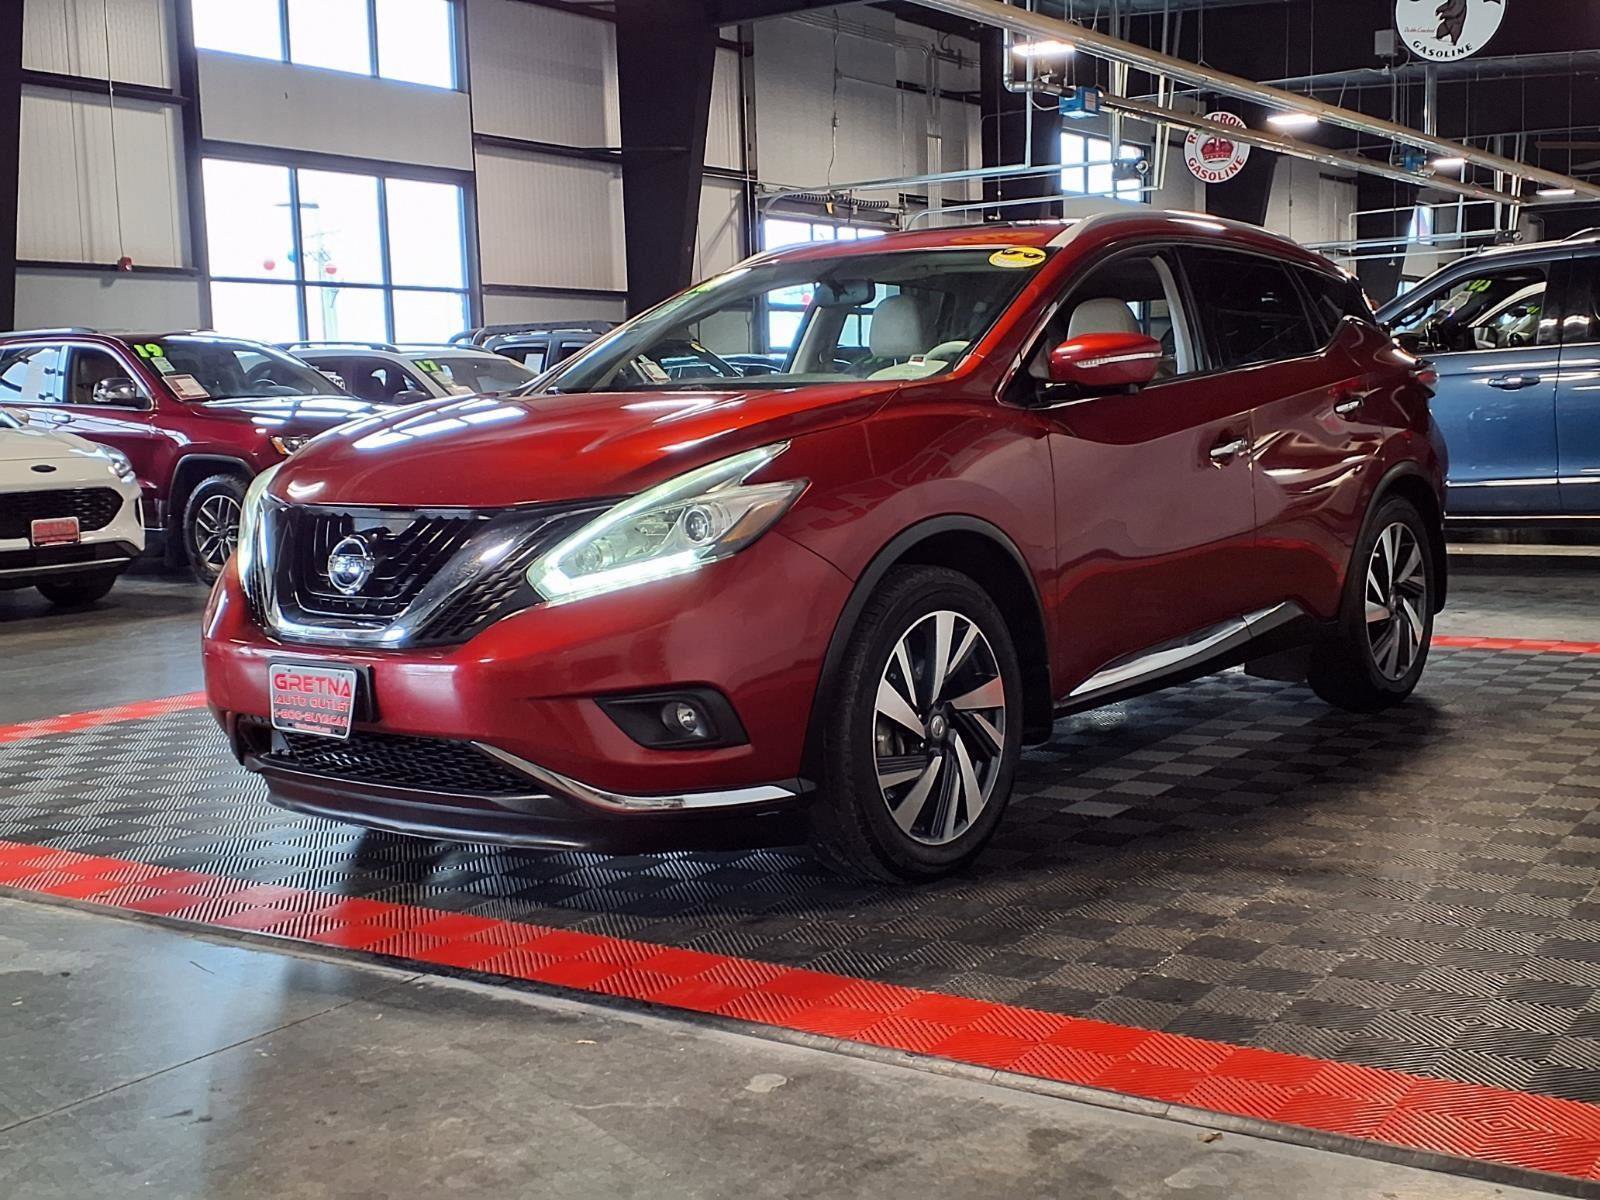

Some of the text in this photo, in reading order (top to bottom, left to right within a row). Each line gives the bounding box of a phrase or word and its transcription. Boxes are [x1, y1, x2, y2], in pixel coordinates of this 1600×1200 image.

[1412, 40, 1473, 58] GASOLINE
[1211, 113, 1244, 128] CRO
[1188, 155, 1245, 181] GASOLINE
[133, 343, 164, 358] 19
[414, 359, 439, 372] 17
[273, 673, 352, 698] GRETNA
[273, 694, 351, 713] AUTO OUTLET
